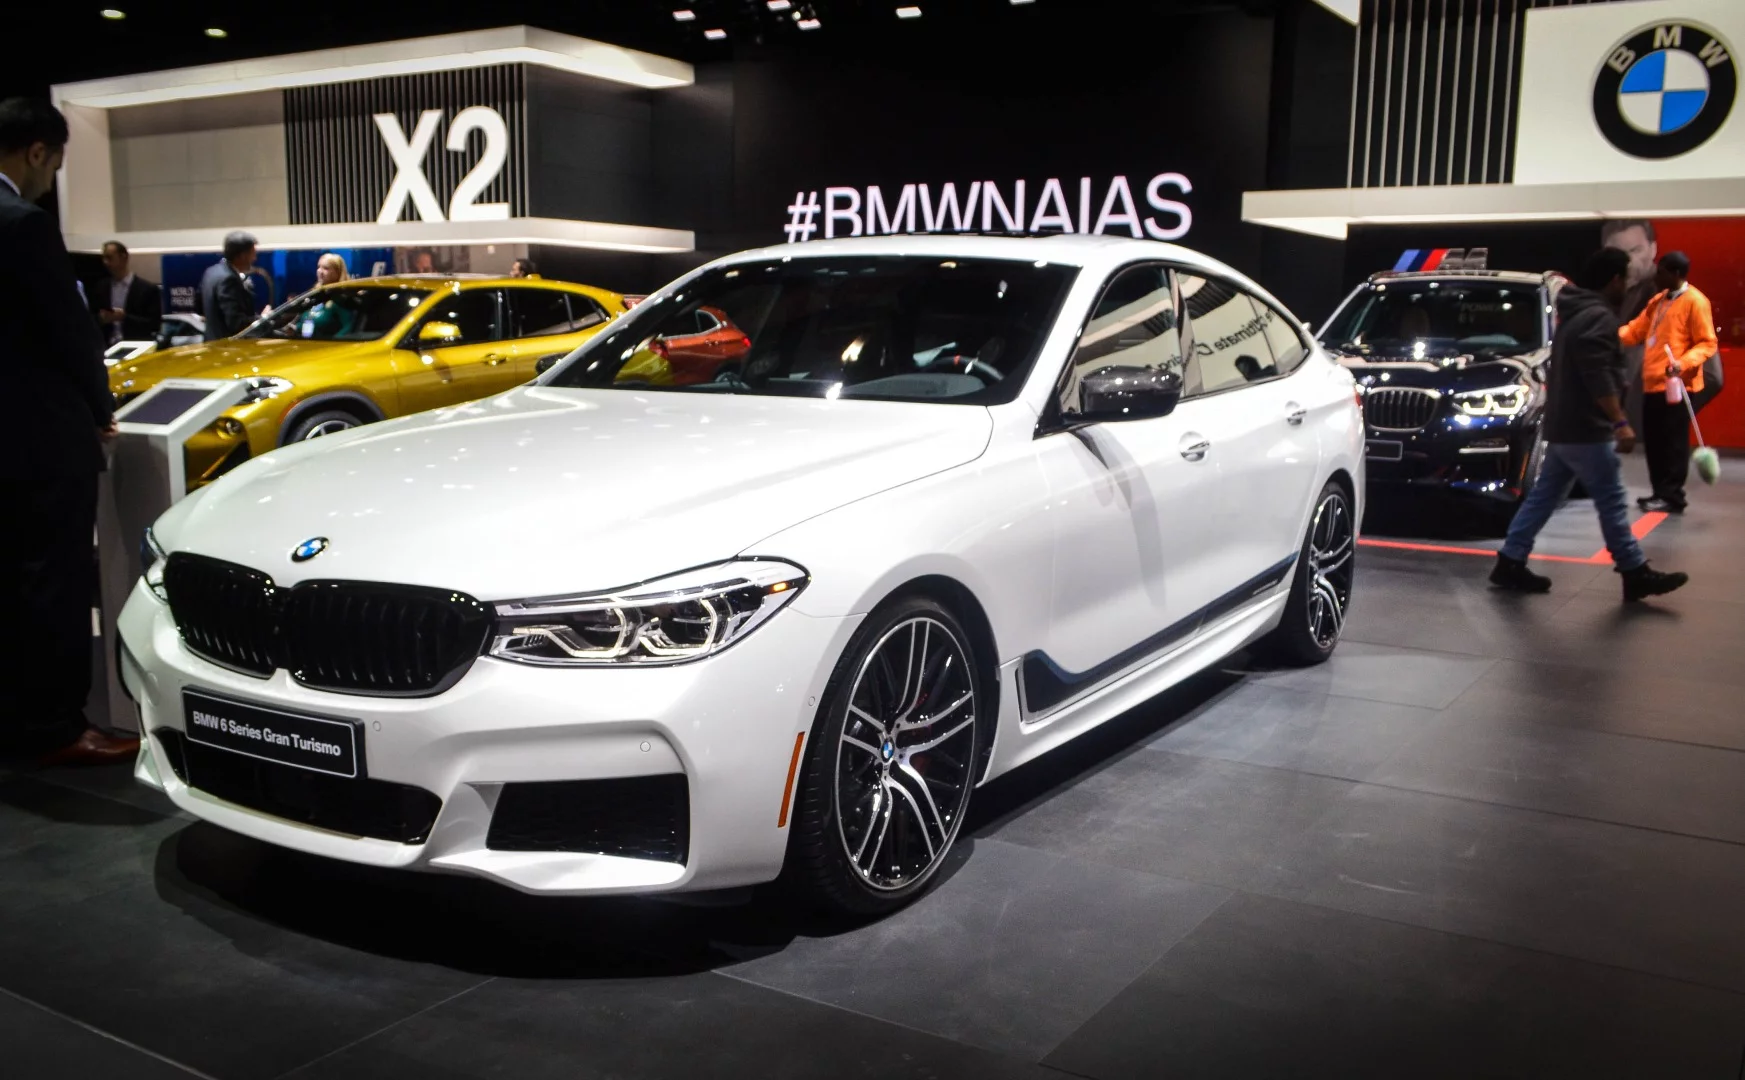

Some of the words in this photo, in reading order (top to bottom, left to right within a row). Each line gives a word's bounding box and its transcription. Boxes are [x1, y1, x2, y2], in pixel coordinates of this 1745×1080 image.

[1606, 25, 1730, 73] BMW
[372, 105, 510, 226] X2
[783, 172, 1193, 244] #BMWNAIAS
[193, 710, 219, 730] BMW
[220, 718, 228, 732] 6
[229, 721, 262, 740] Series
[263, 727, 290, 747] Gran
[291, 733, 341, 757] Turismo
